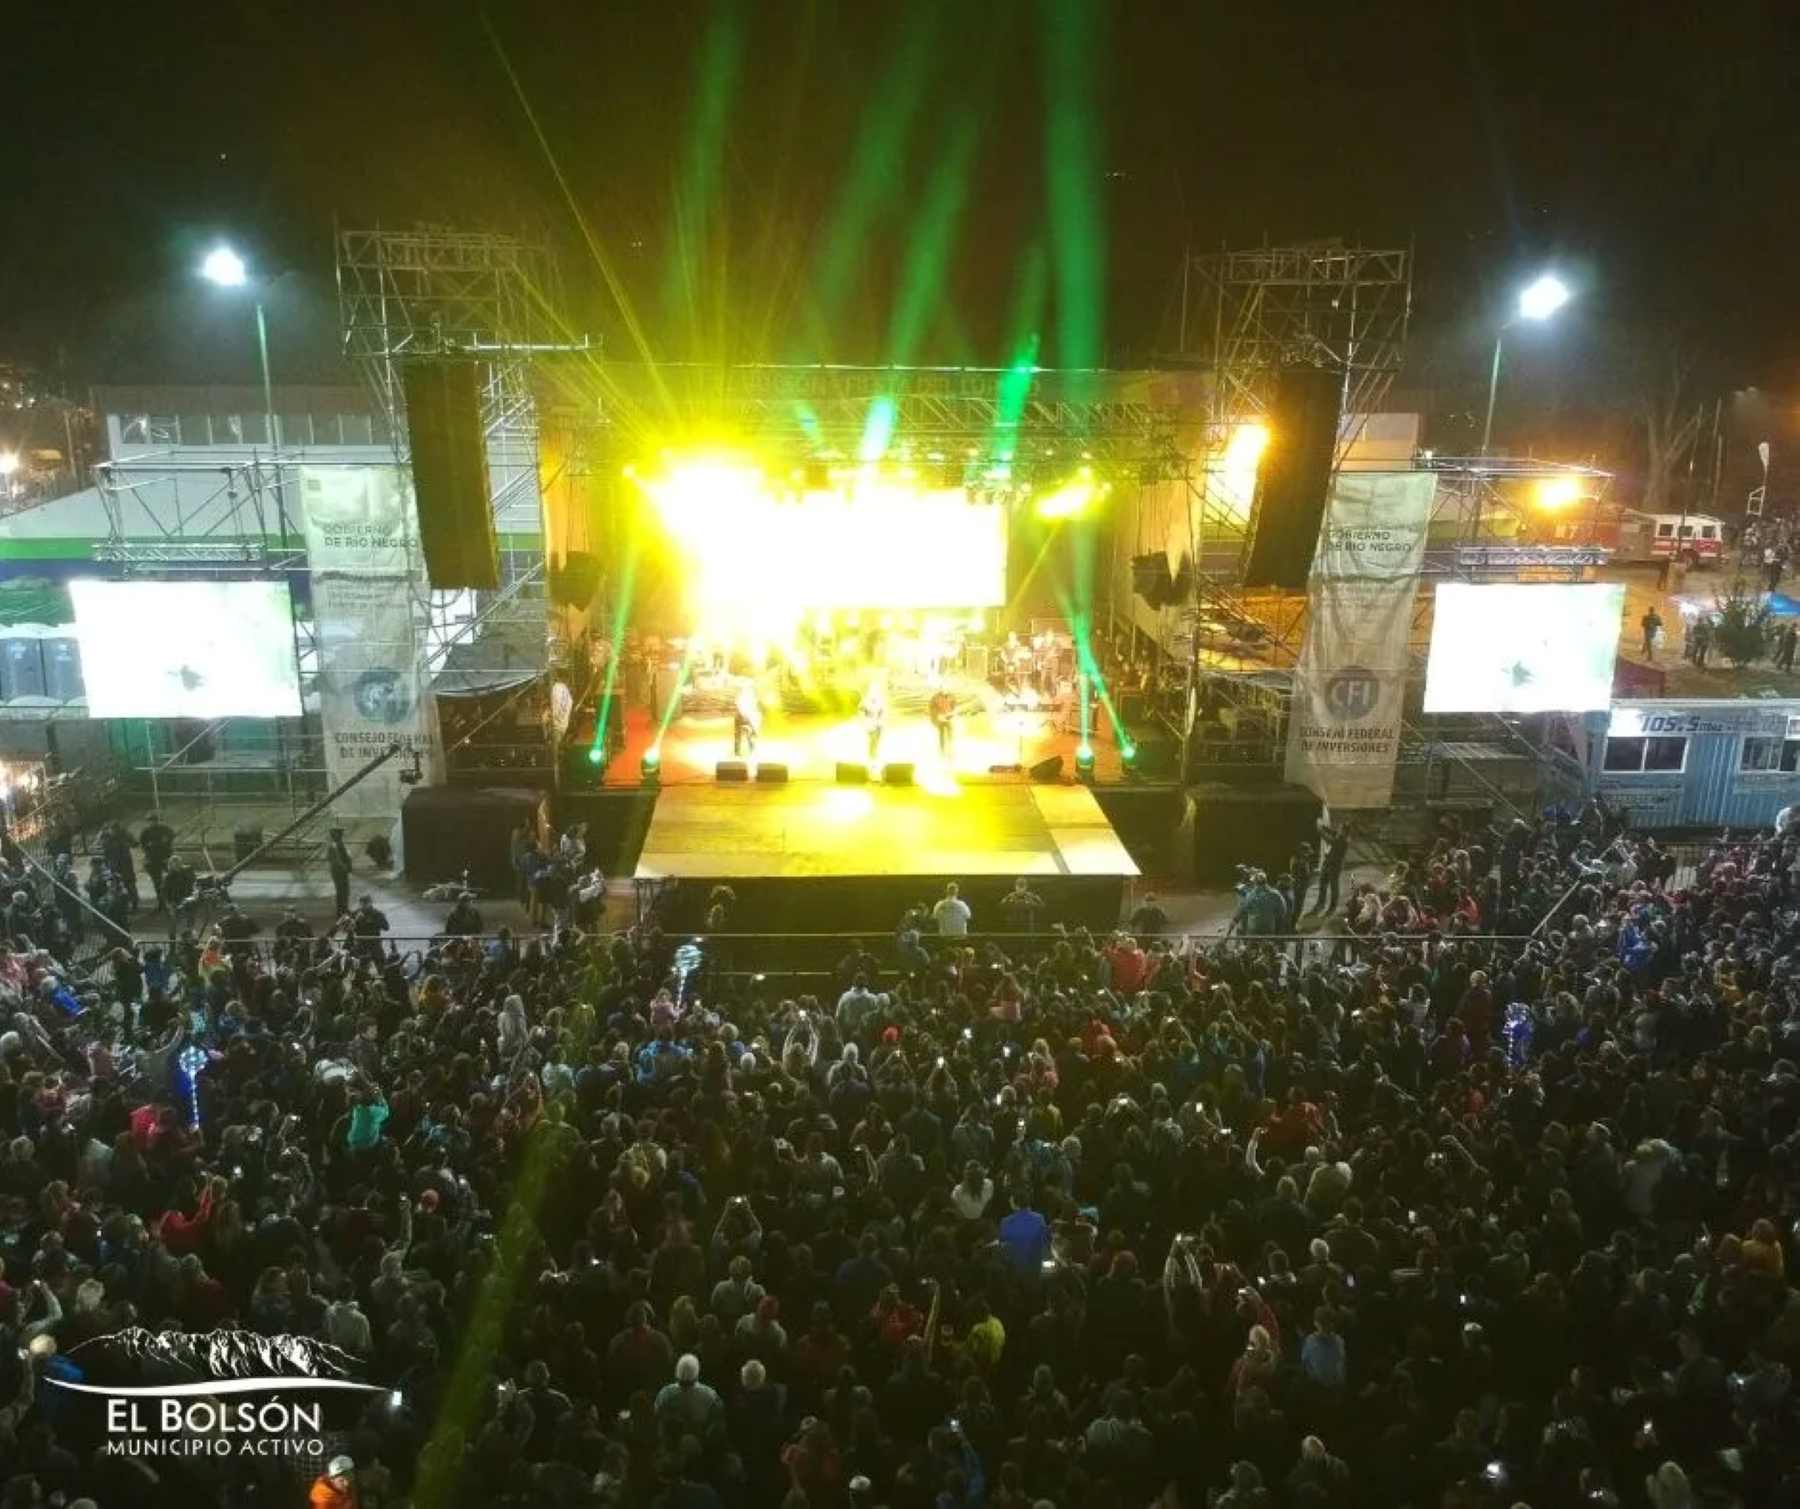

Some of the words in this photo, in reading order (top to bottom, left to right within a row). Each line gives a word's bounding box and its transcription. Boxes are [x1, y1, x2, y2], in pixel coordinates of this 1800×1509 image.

[325, 537, 341, 547] DE
[1369, 542, 1411, 552] NEGRO
[1349, 728, 1393, 738] FEDERAL
[1316, 741, 1390, 752] INVERSIONES
